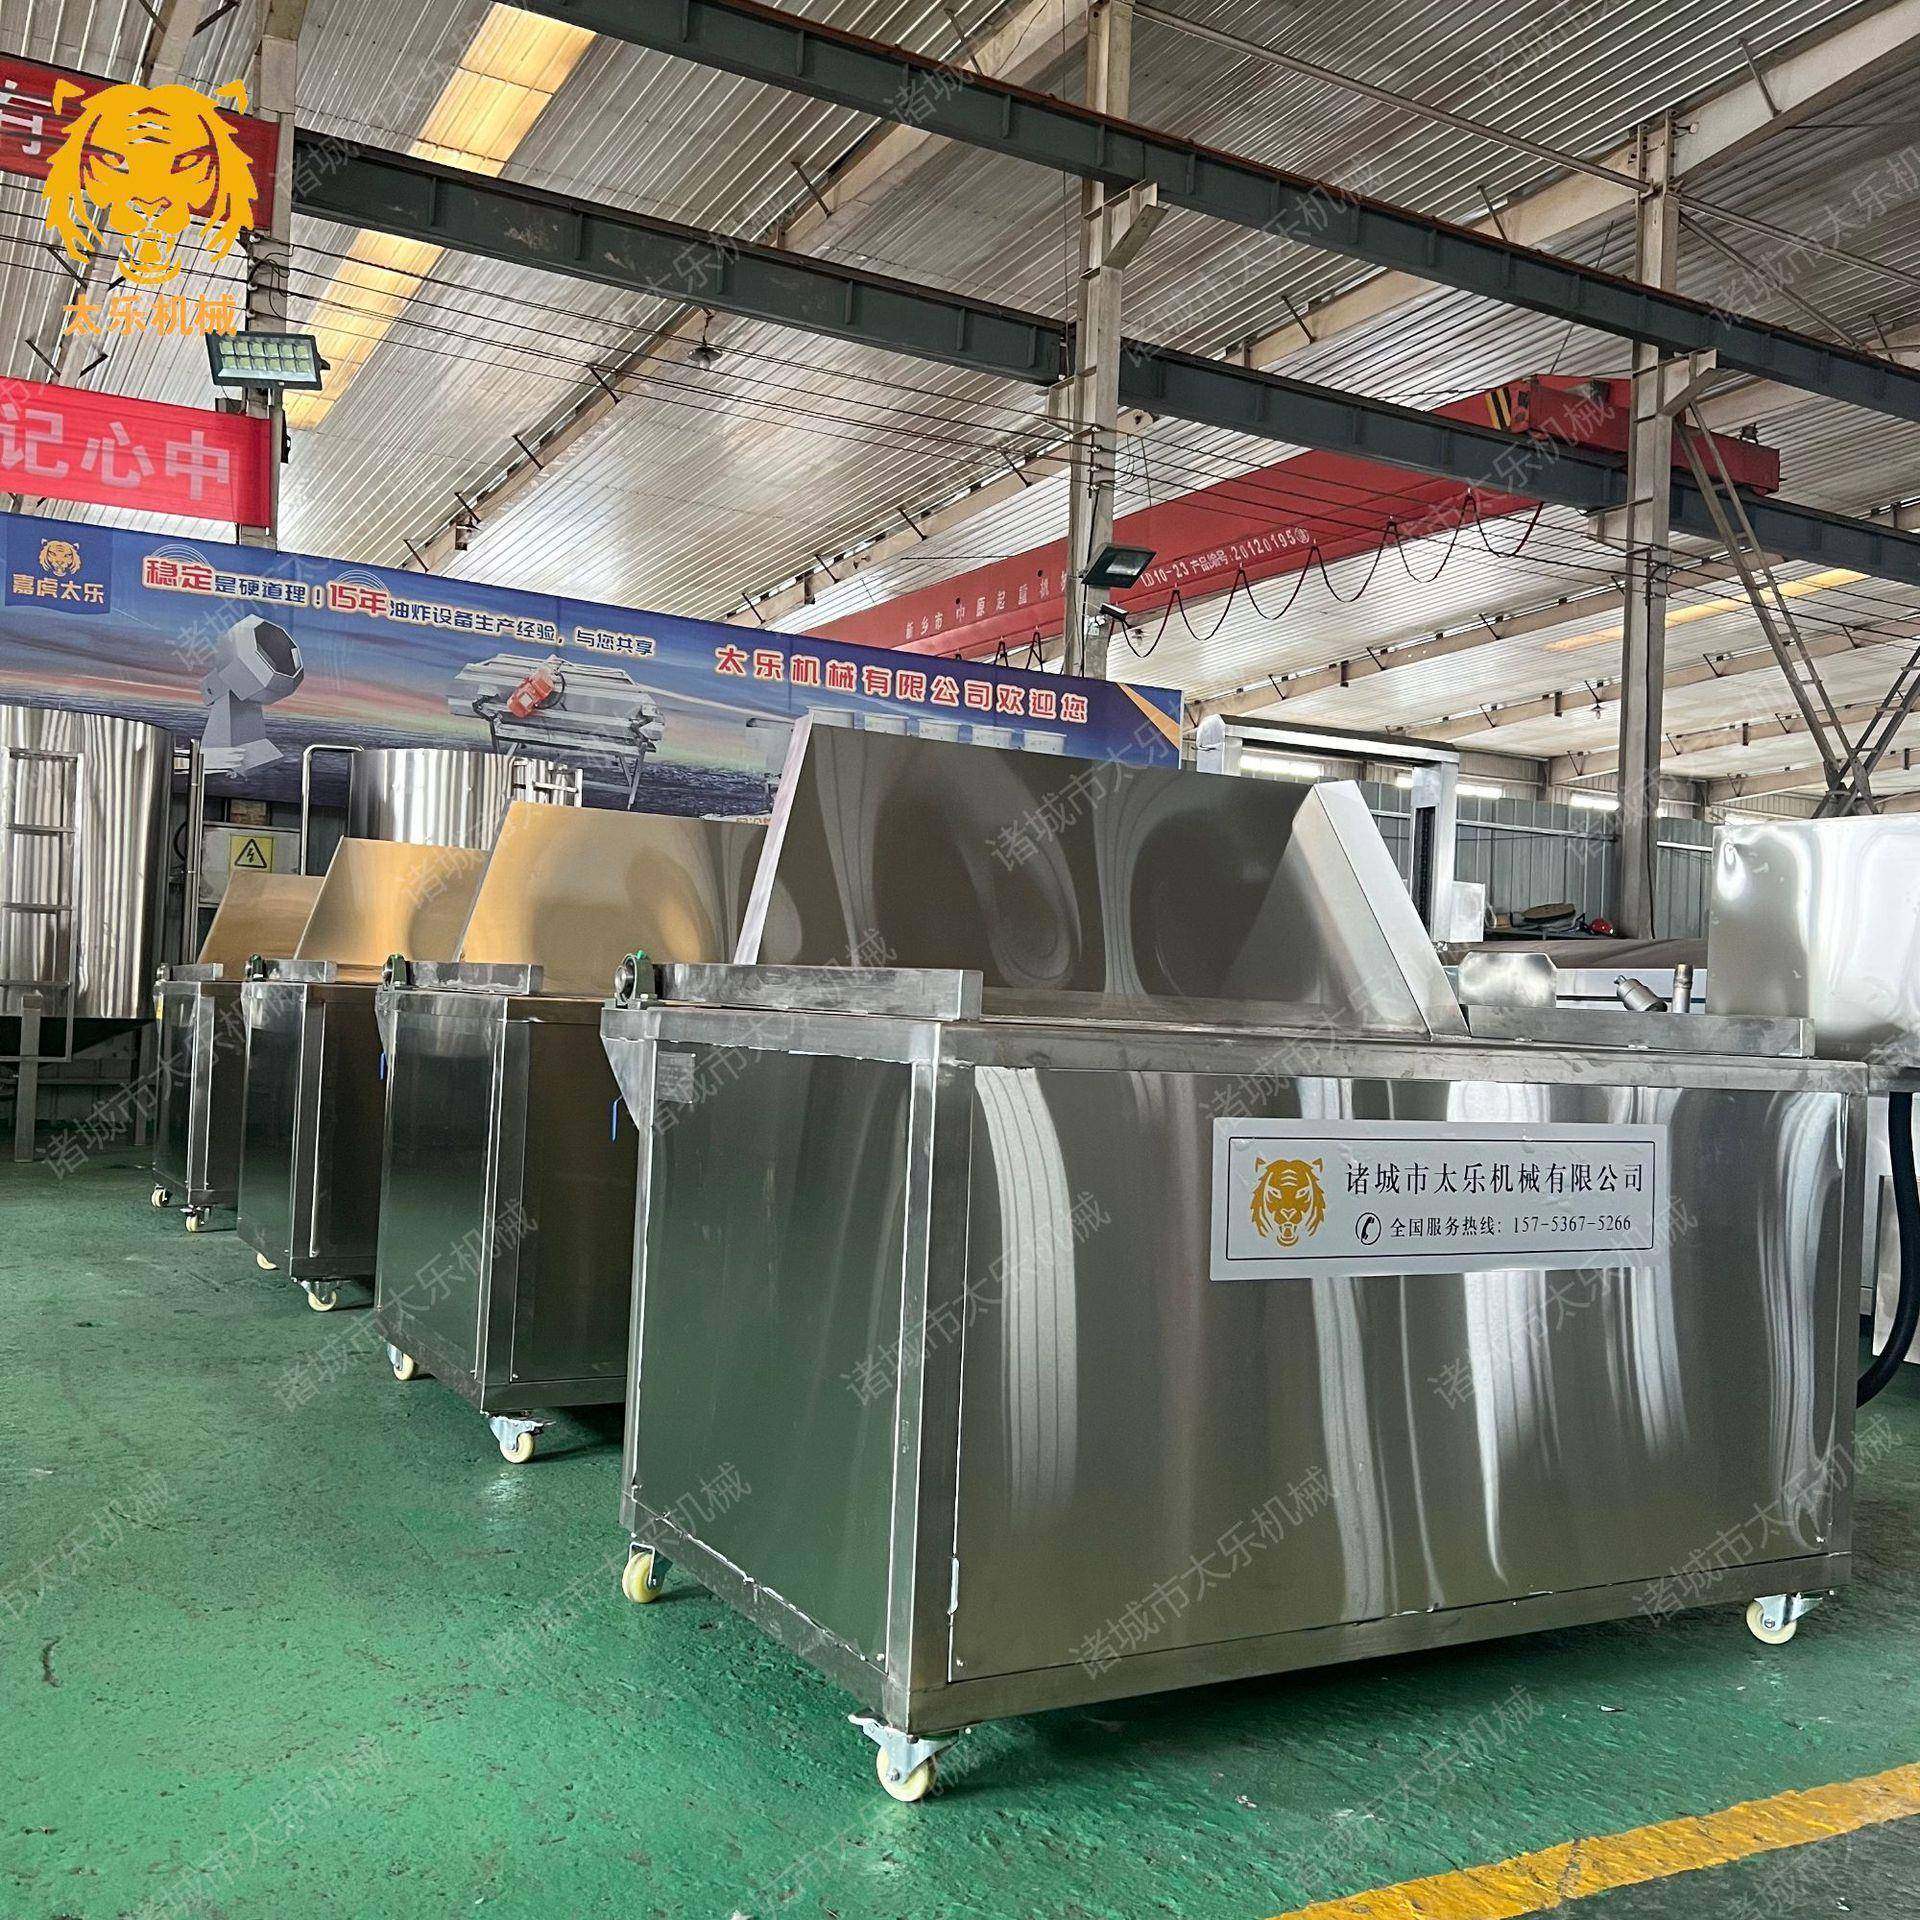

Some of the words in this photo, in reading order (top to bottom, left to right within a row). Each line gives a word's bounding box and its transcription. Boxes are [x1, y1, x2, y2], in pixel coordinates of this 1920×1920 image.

[0, 402, 231, 500] 记心中
[12, 573, 104, 604] 嘉虎太乐
[715, 645, 1089, 722] 太乐机械有限公司欢迎您
[1346, 1161, 1643, 1195] 诸城市太乐机械有限公司
[1513, 1214, 1631, 1234] 157-5367-5266
